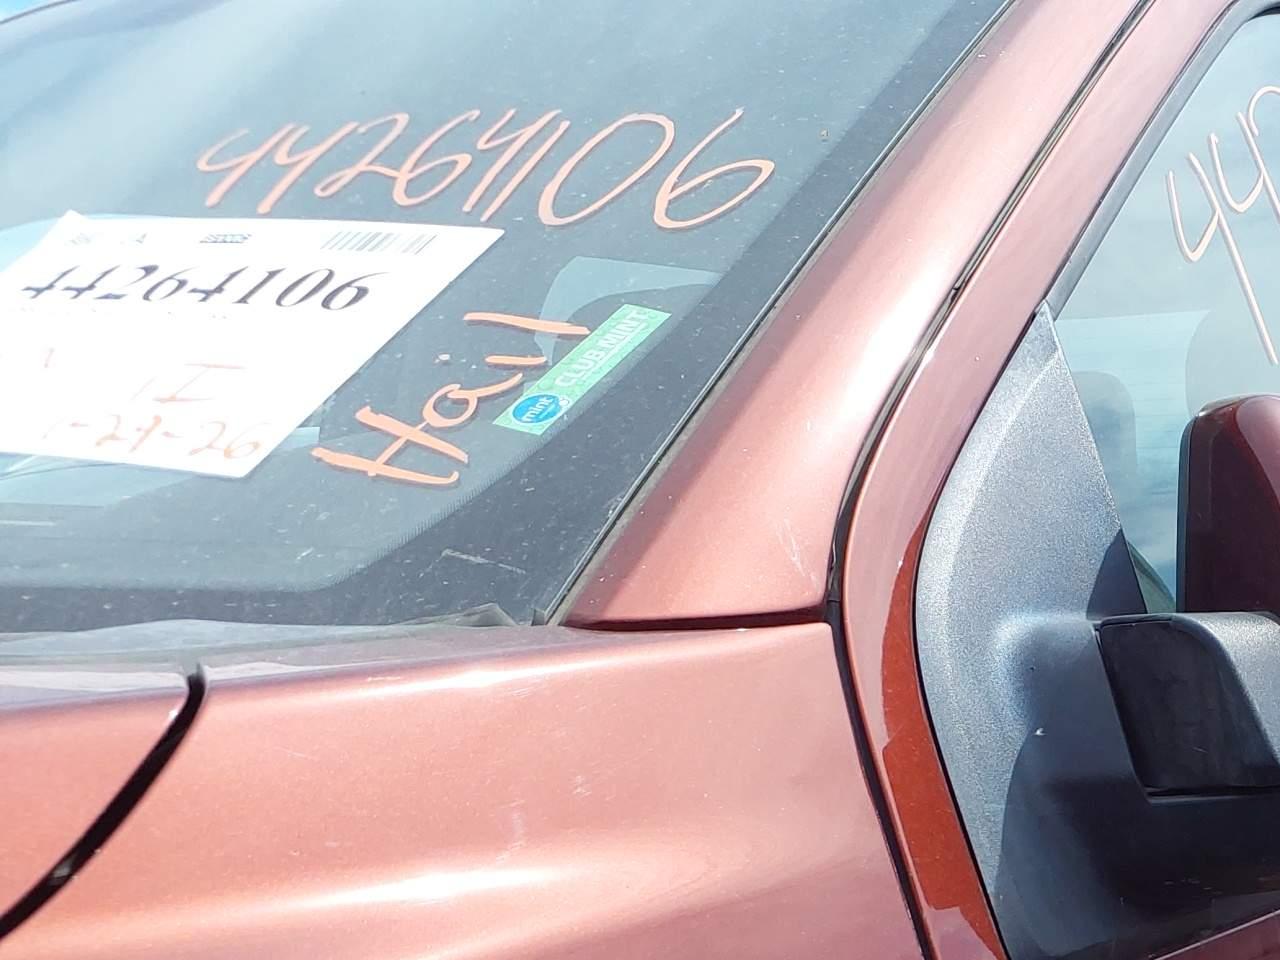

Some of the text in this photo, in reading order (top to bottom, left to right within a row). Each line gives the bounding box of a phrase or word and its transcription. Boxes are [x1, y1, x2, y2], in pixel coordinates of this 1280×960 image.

[197, 108, 776, 229] 44264106
[21, 264, 390, 311] 44264106
[311, 312, 591, 485] Hail
[521, 309, 649, 423] mint CLUB MINT
